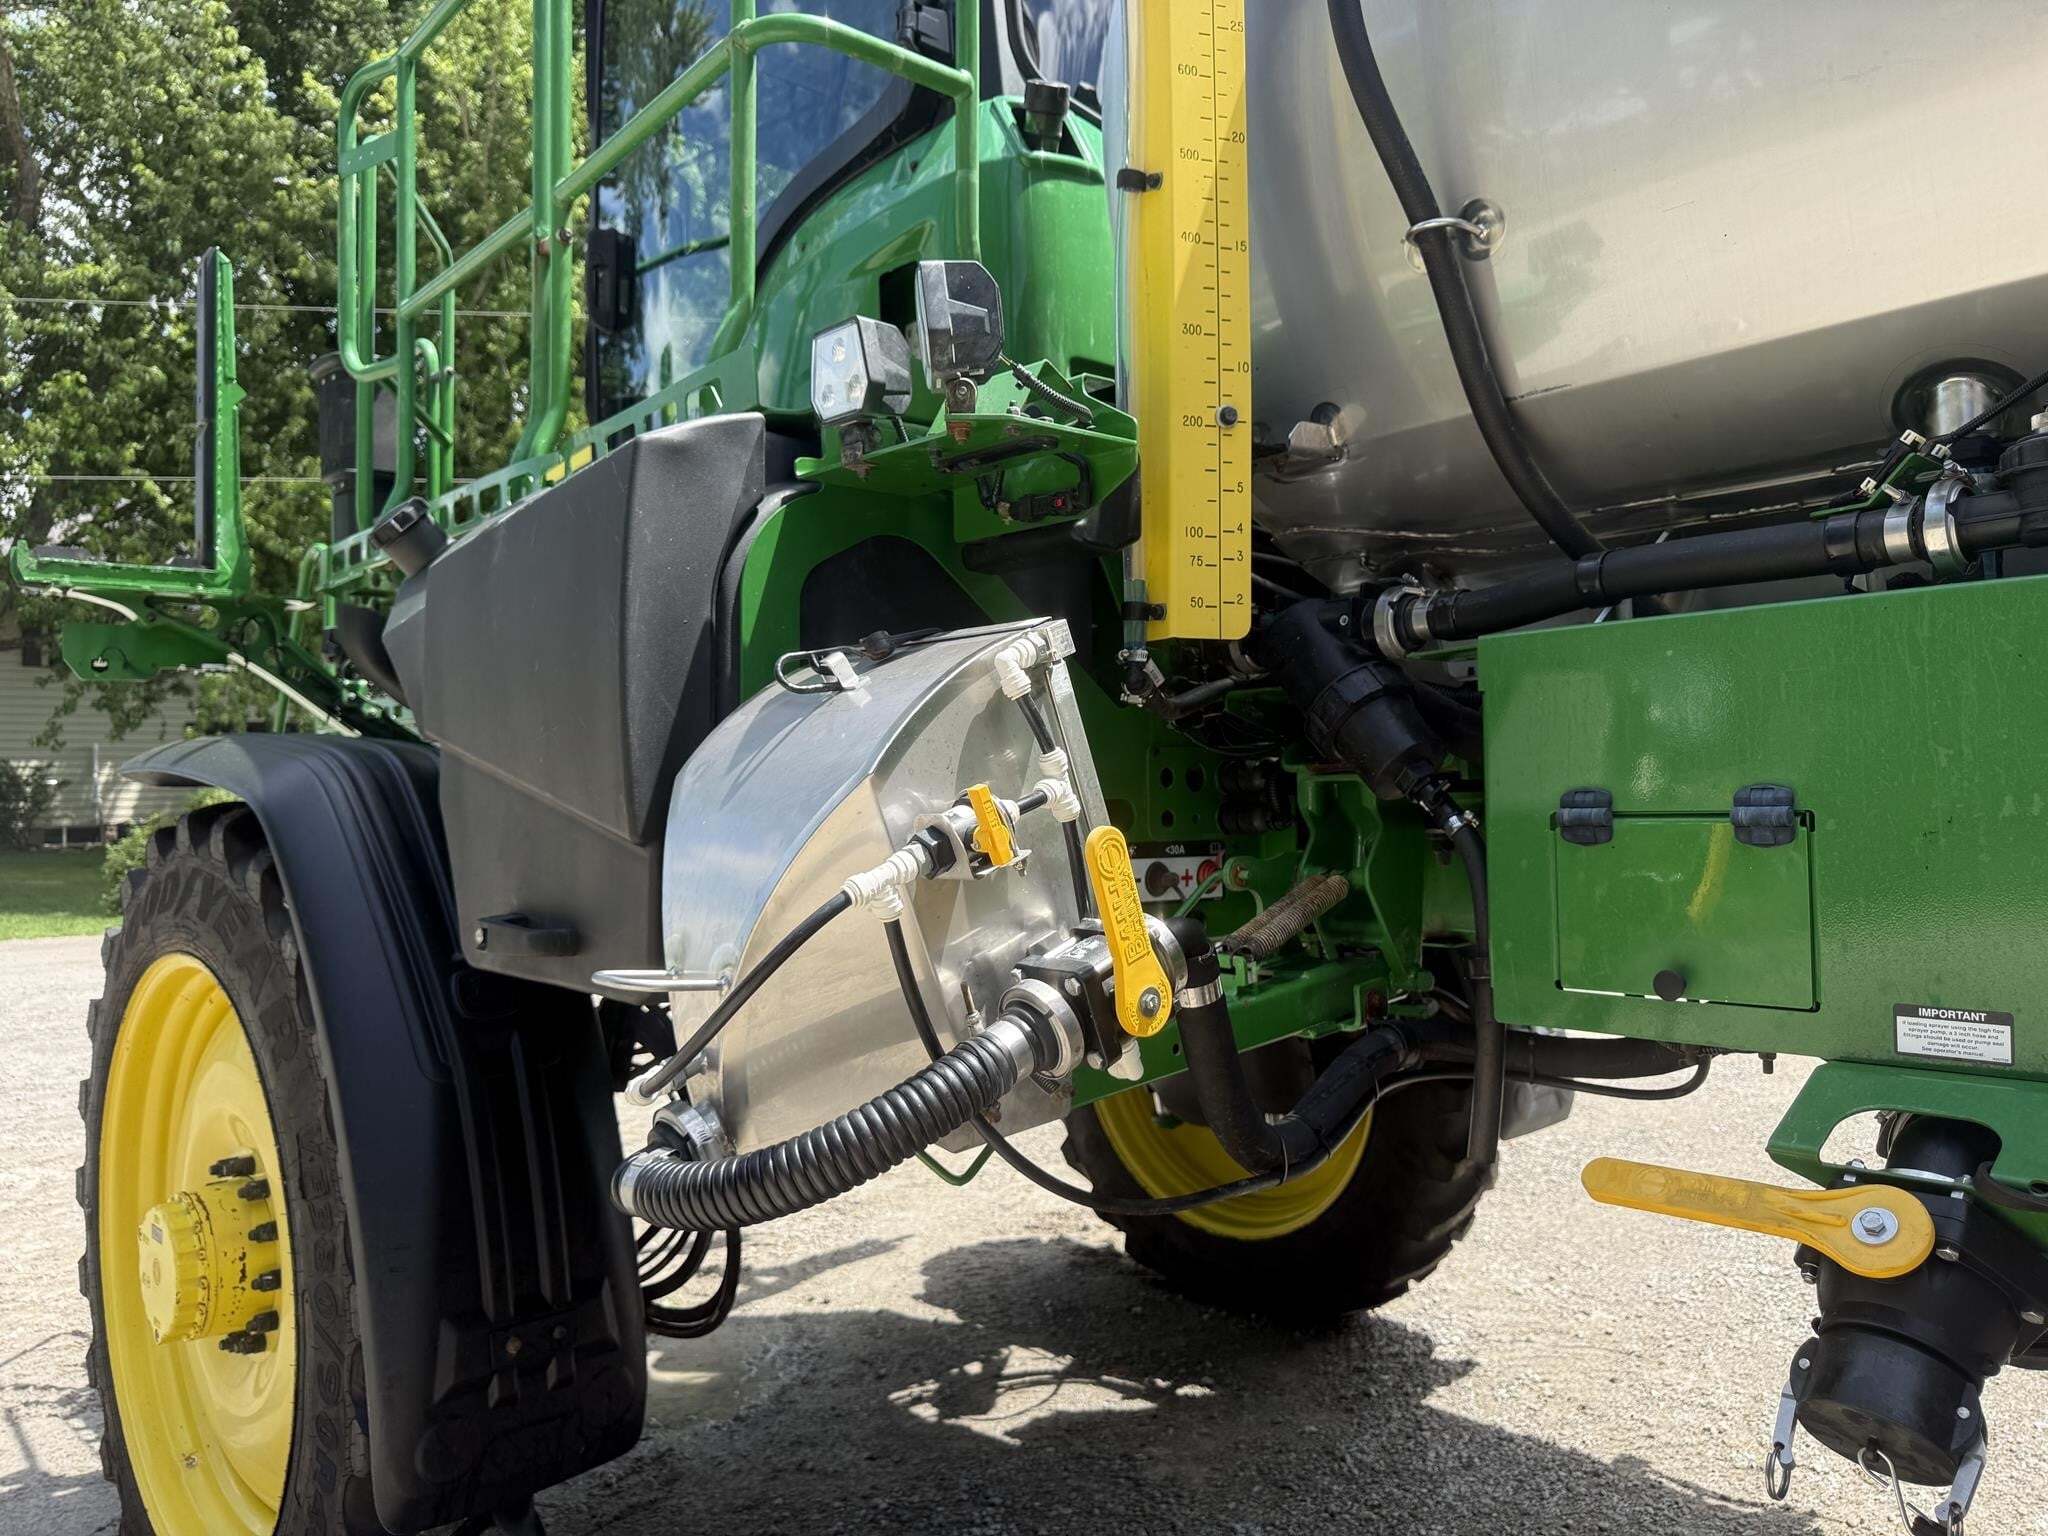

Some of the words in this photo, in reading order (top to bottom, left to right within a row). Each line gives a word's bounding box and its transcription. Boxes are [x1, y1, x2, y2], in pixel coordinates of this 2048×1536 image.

[1230, 20, 1244, 33] 25
[1177, 63, 1198, 77] 600
[1231, 131, 1245, 144] 20
[1179, 148, 1200, 161] 500
[1181, 231, 1201, 244] 400
[1235, 240, 1248, 253] 15
[1182, 323, 1202, 336] 300
[1237, 361, 1249, 373] 10
[1182, 415, 1203, 427] 200
[1236, 481, 1244, 493] 5
[1185, 526, 1204, 538] 100
[1236, 523, 1244, 535] 4
[1190, 555, 1203, 567] 75
[1236, 550, 1244, 562] 3
[1190, 596, 1204, 608] 50
[1236, 593, 1244, 605] 2
[1918, 1008, 1987, 1022] IMPORTANT
